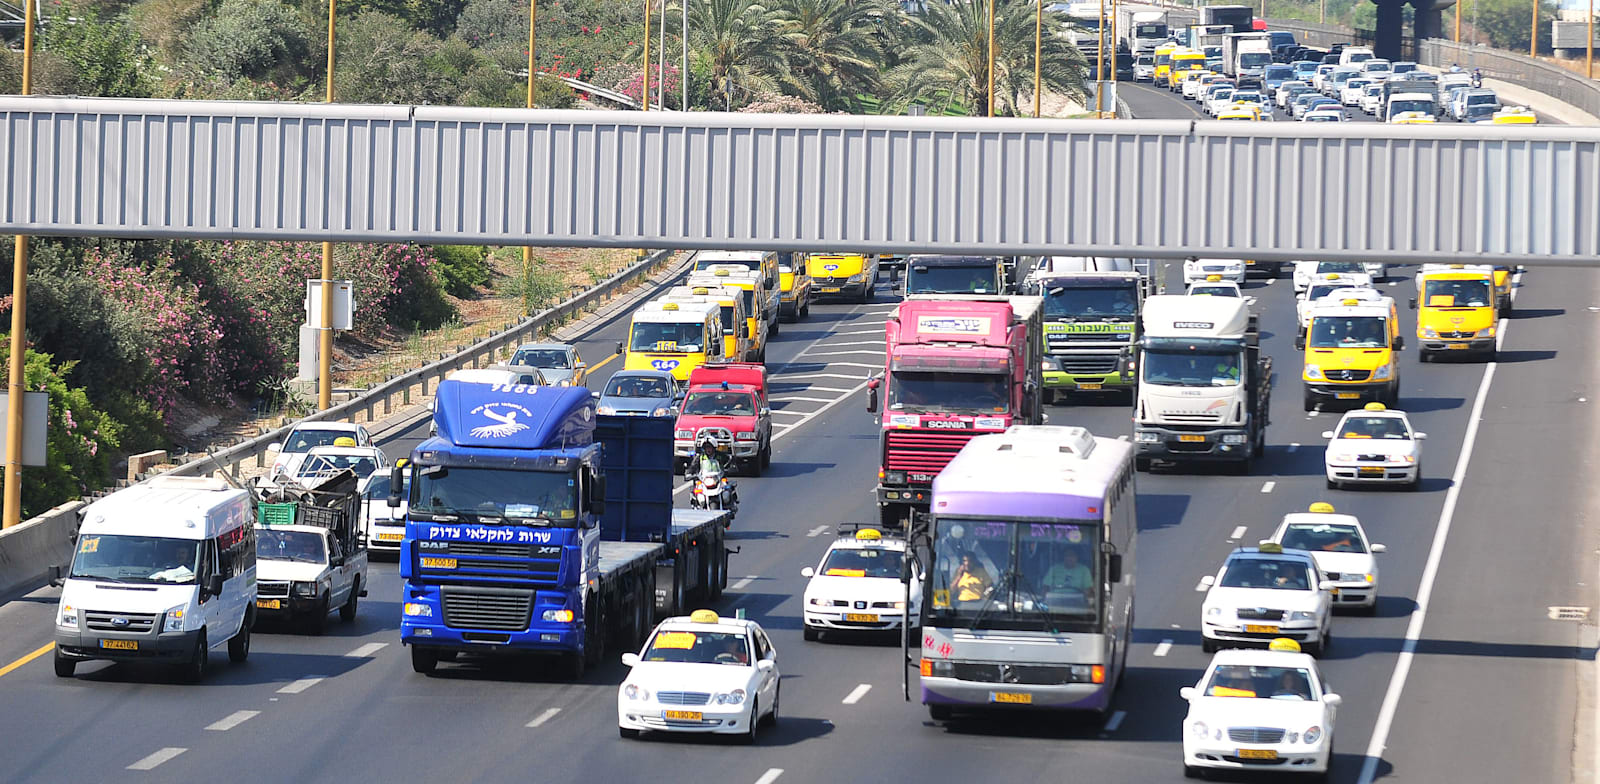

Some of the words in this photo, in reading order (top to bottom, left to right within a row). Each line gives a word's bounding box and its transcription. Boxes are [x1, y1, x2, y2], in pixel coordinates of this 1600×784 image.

[1068, 324, 1111, 332] תעבורה
[658, 342, 676, 352] 164
[654, 361, 676, 369] 164
[928, 420, 967, 429] SCANIA
[429, 526, 461, 540] צדוק
[465, 527, 514, 543] לחקלאי
[518, 530, 552, 543] שרות
[420, 541, 449, 549] DAF
[537, 546, 561, 554] XF
